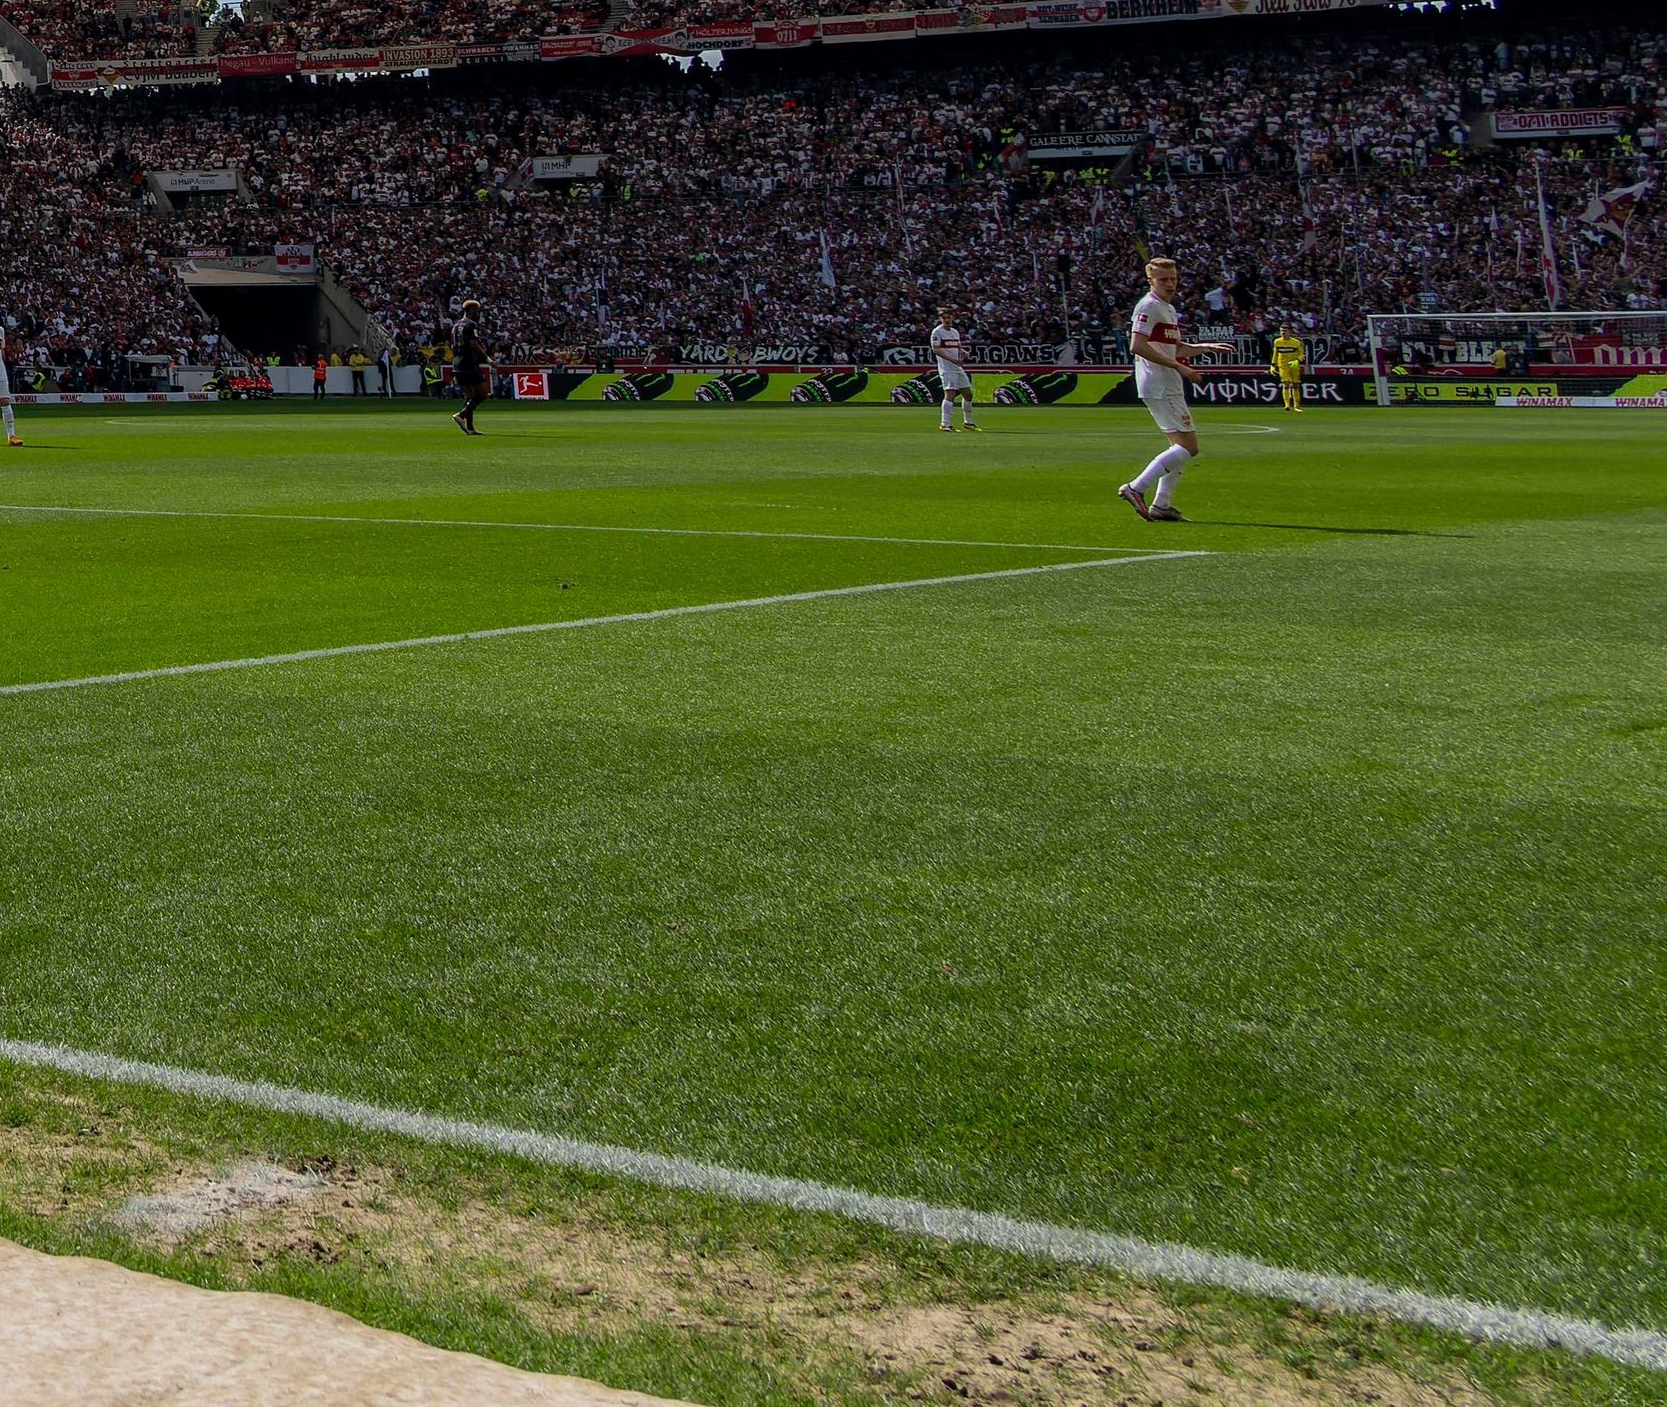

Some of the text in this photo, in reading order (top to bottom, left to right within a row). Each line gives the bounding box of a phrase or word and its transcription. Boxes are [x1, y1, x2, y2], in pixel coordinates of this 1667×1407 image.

[688, 39, 744, 50] HOCHDORF
[383, 47, 454, 61] INVASION 1893
[123, 57, 214, 69] Stuttgarter
[384, 58, 454, 68] STRAUBENHARDT
[1550, 112, 1608, 127] ADDICTS
[1029, 135, 1083, 147] GALEERE
[551, 162, 571, 171] MHP
[679, 344, 820, 364] YARD BWOYS
[1192, 378, 1344, 402] MONSER
[1516, 397, 1572, 406] WINAMAX
